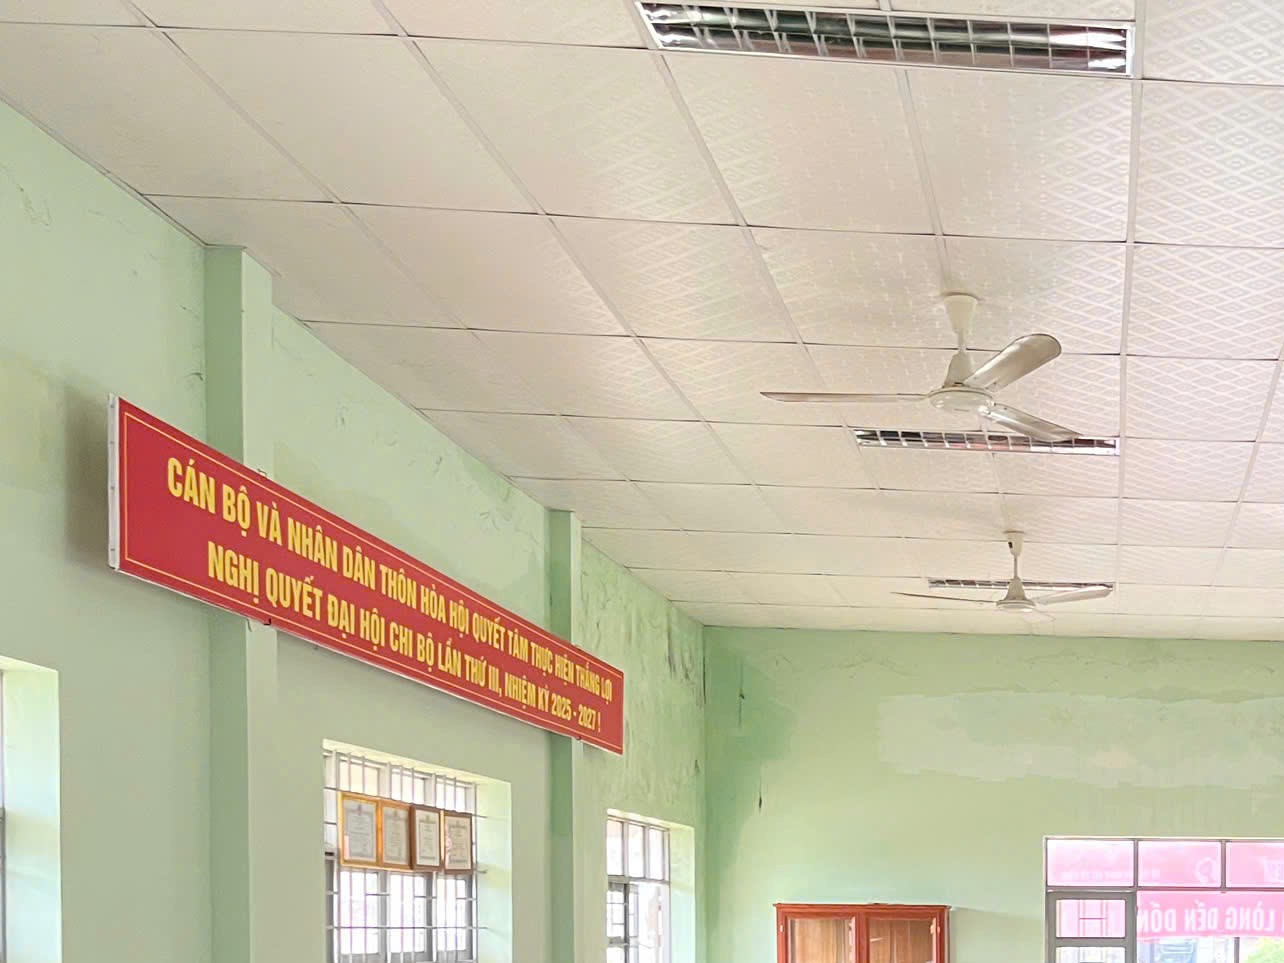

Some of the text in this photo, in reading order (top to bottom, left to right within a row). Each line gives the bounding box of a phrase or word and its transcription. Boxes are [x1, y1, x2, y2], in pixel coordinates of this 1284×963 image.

[167, 457, 613, 705] CÁN BỘ VÀ NHÂN DÂN THÔN HÒA HỘI QUYẾT TÂM THỰC HIỆN THẮNG LỢI
[207, 540, 260, 605] NGHỊ
[265, 567, 323, 621] QUYẾT
[327, 593, 355, 639] ĐẠI
[359, 607, 386, 651] HỘI
[389, 621, 414, 659] CHI
[416, 631, 435, 673] BỘ
[464, 654, 487, 688] THỨ
[504, 671, 537, 710] NHIỆM
[551, 692, 572, 721] 2025
[578, 703, 596, 731] 2027
